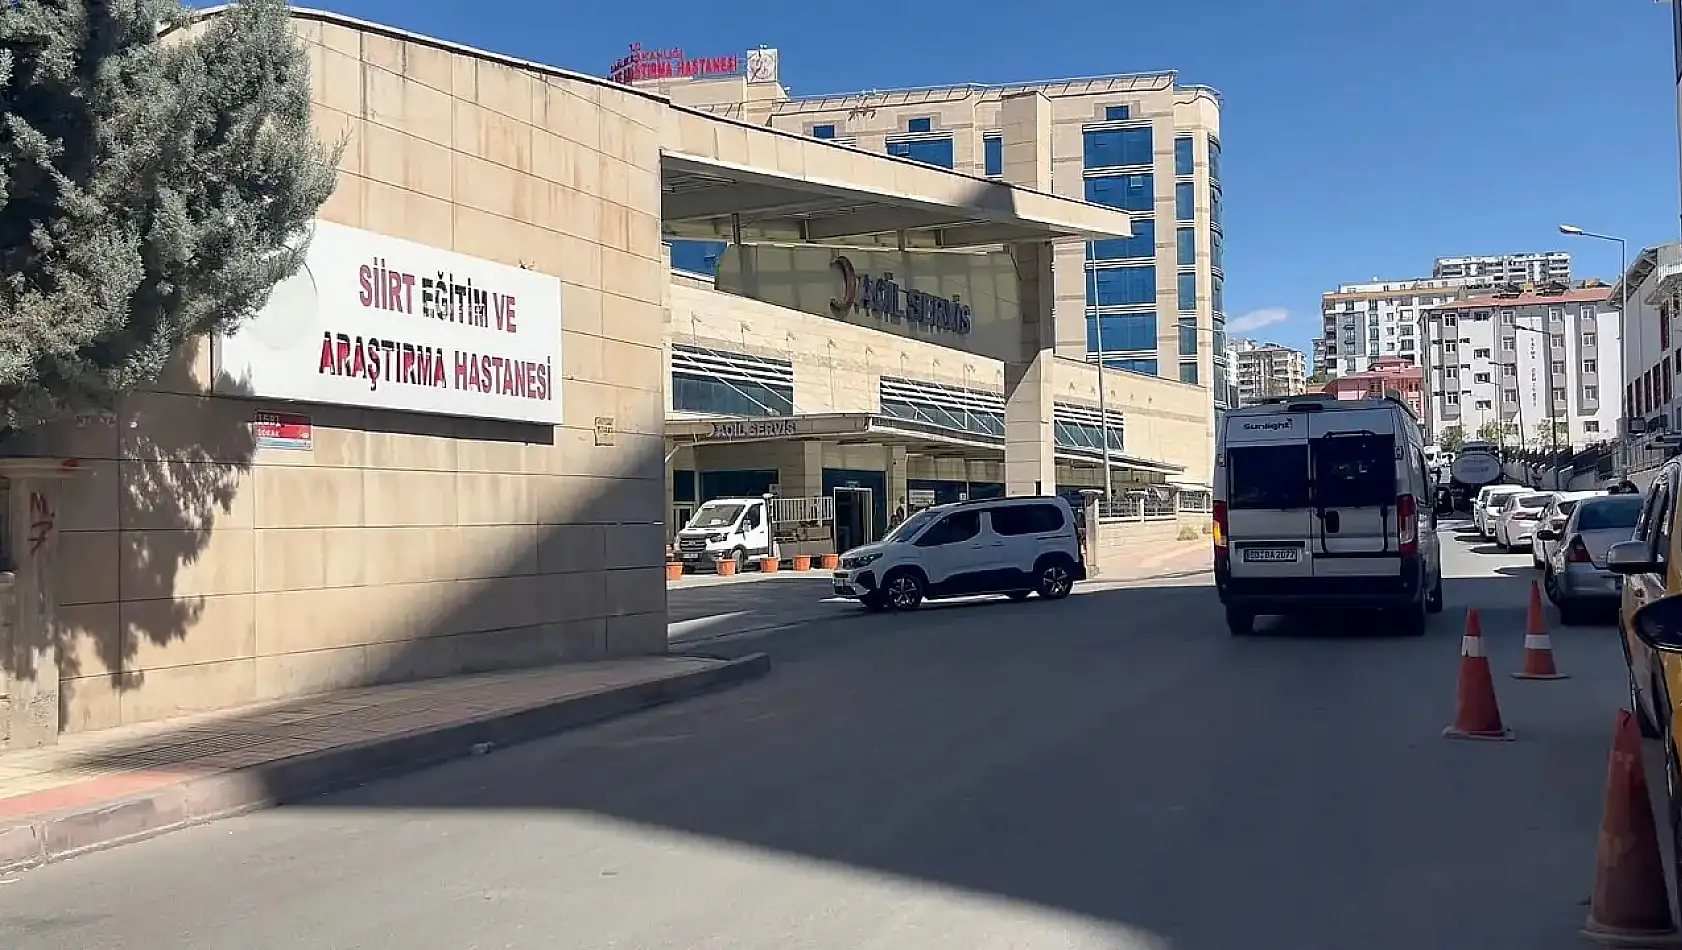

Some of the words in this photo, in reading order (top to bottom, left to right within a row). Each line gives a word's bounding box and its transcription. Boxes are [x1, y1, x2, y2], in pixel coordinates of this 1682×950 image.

[359, 256, 416, 315] SİİRT
[421, 270, 489, 328] EĞİTİM
[492, 292, 517, 334] VE
[318, 331, 447, 392] ARAŞTIRMA
[454, 350, 552, 401] HASTANESİ
[1243, 421, 1290, 430] Sunlight
